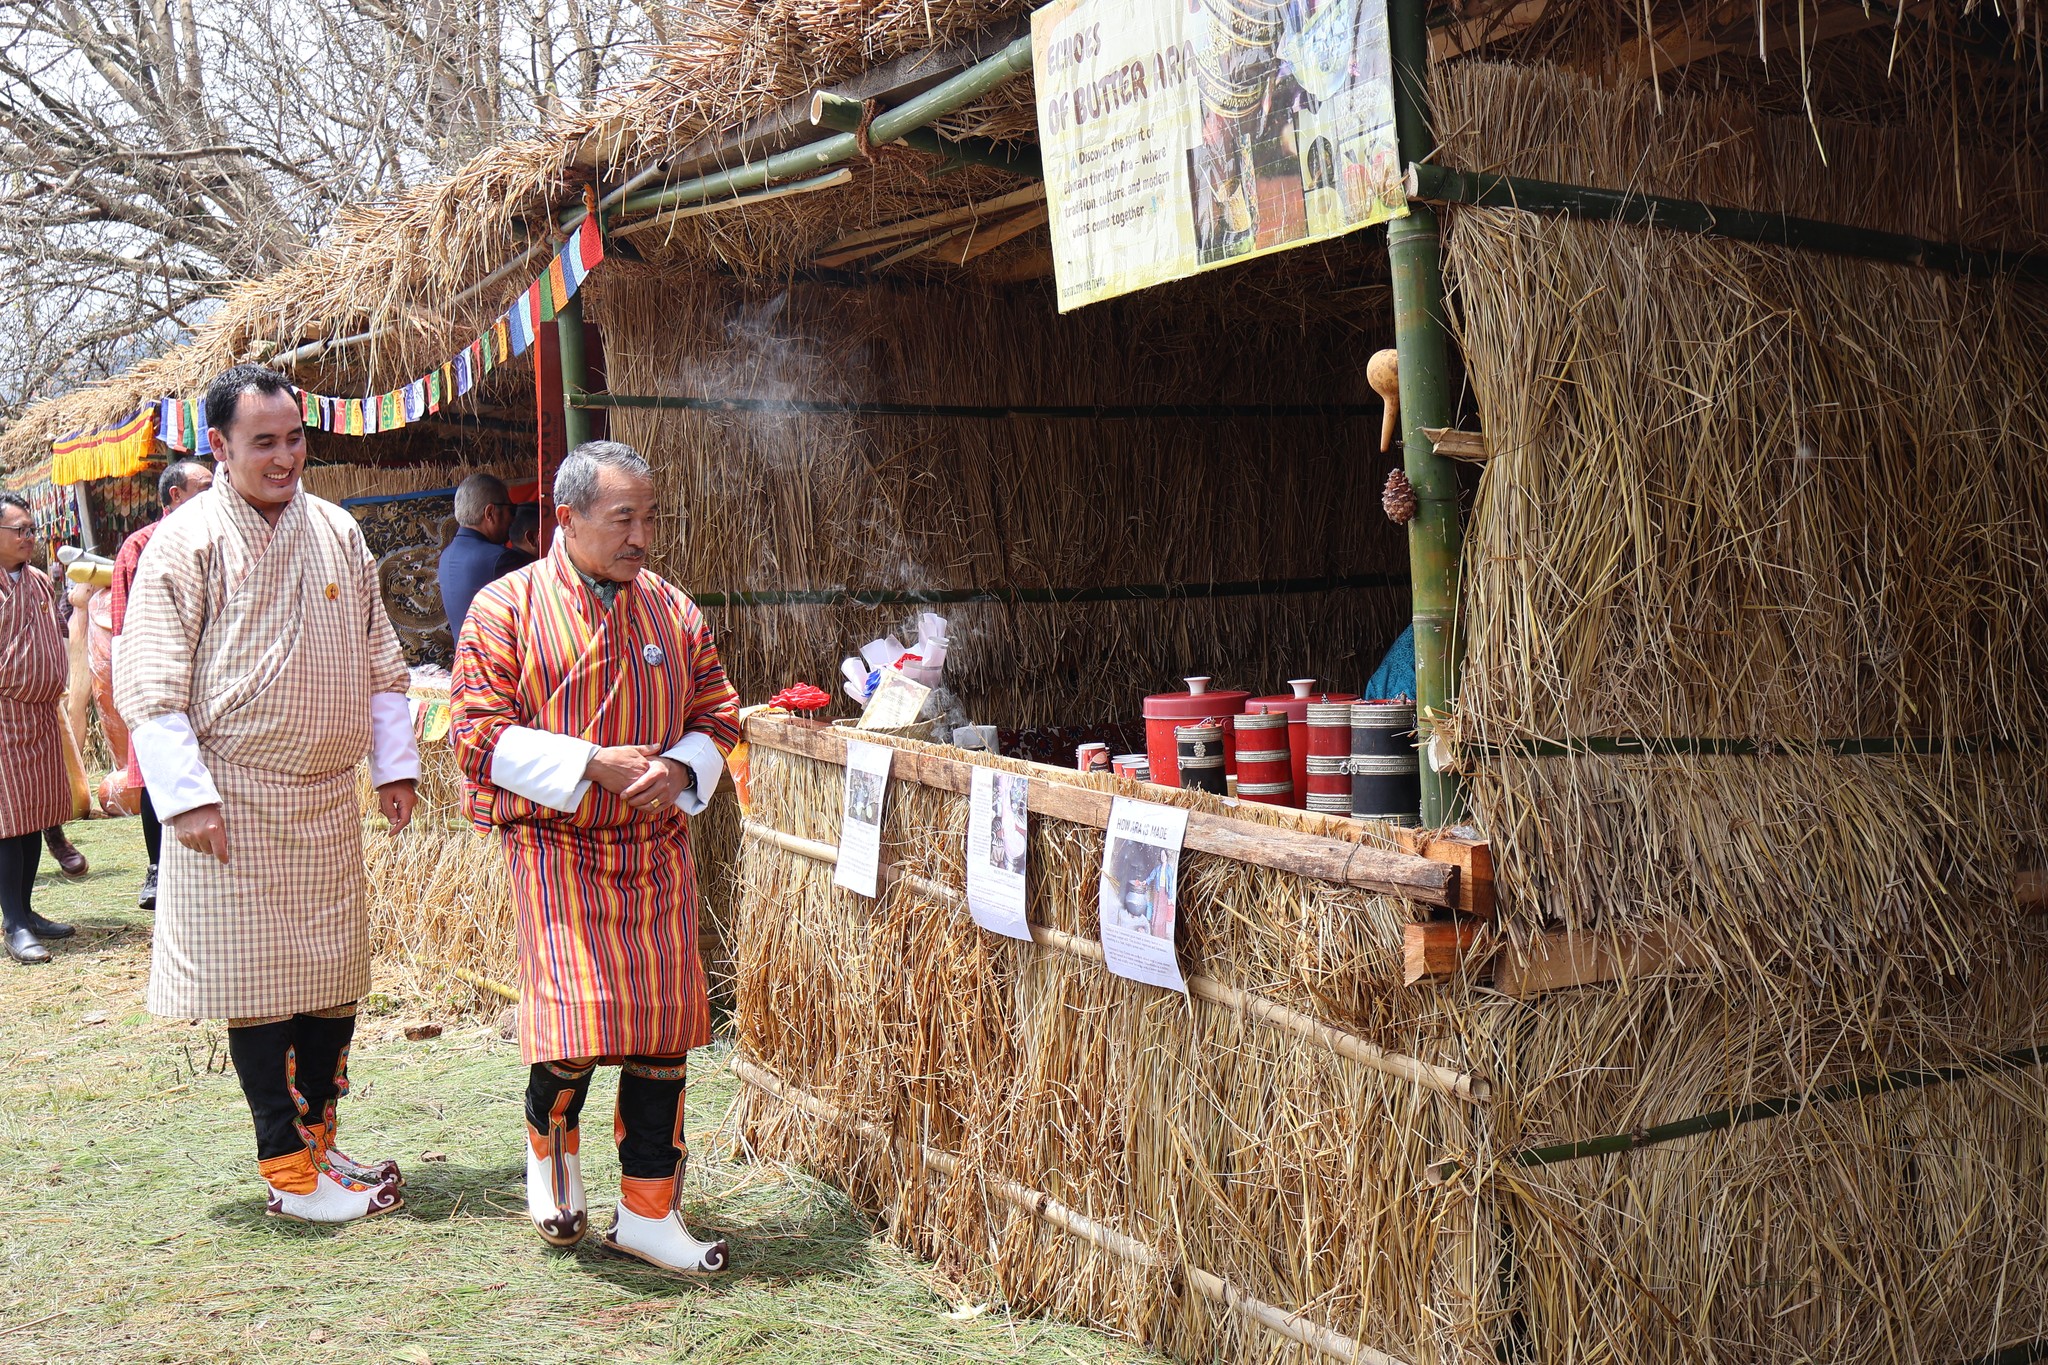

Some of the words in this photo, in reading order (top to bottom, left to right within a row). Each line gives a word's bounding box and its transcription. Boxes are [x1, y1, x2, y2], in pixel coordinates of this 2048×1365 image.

[1048, 22, 1101, 76] ECHOES
[1048, 92, 1068, 136] OF
[1074, 60, 1148, 125] BUTTER
[1153, 40, 1198, 92] ARA
[1079, 143, 1110, 165] Discover
[1112, 138, 1124, 151] the
[1126, 127, 1145, 150] spirit
[1147, 123, 1154, 140] of
[1090, 164, 1118, 186] through
[1121, 160, 1134, 174] Ara
[1128, 179, 1140, 196] and
[1143, 171, 1170, 190] modern
[1072, 222, 1090, 238] vibes
[1092, 216, 1110, 232] come
[1116, 818, 1130, 831] HOW
[1130, 821, 1142, 834] ARA
[1150, 825, 1168, 840] MADE
